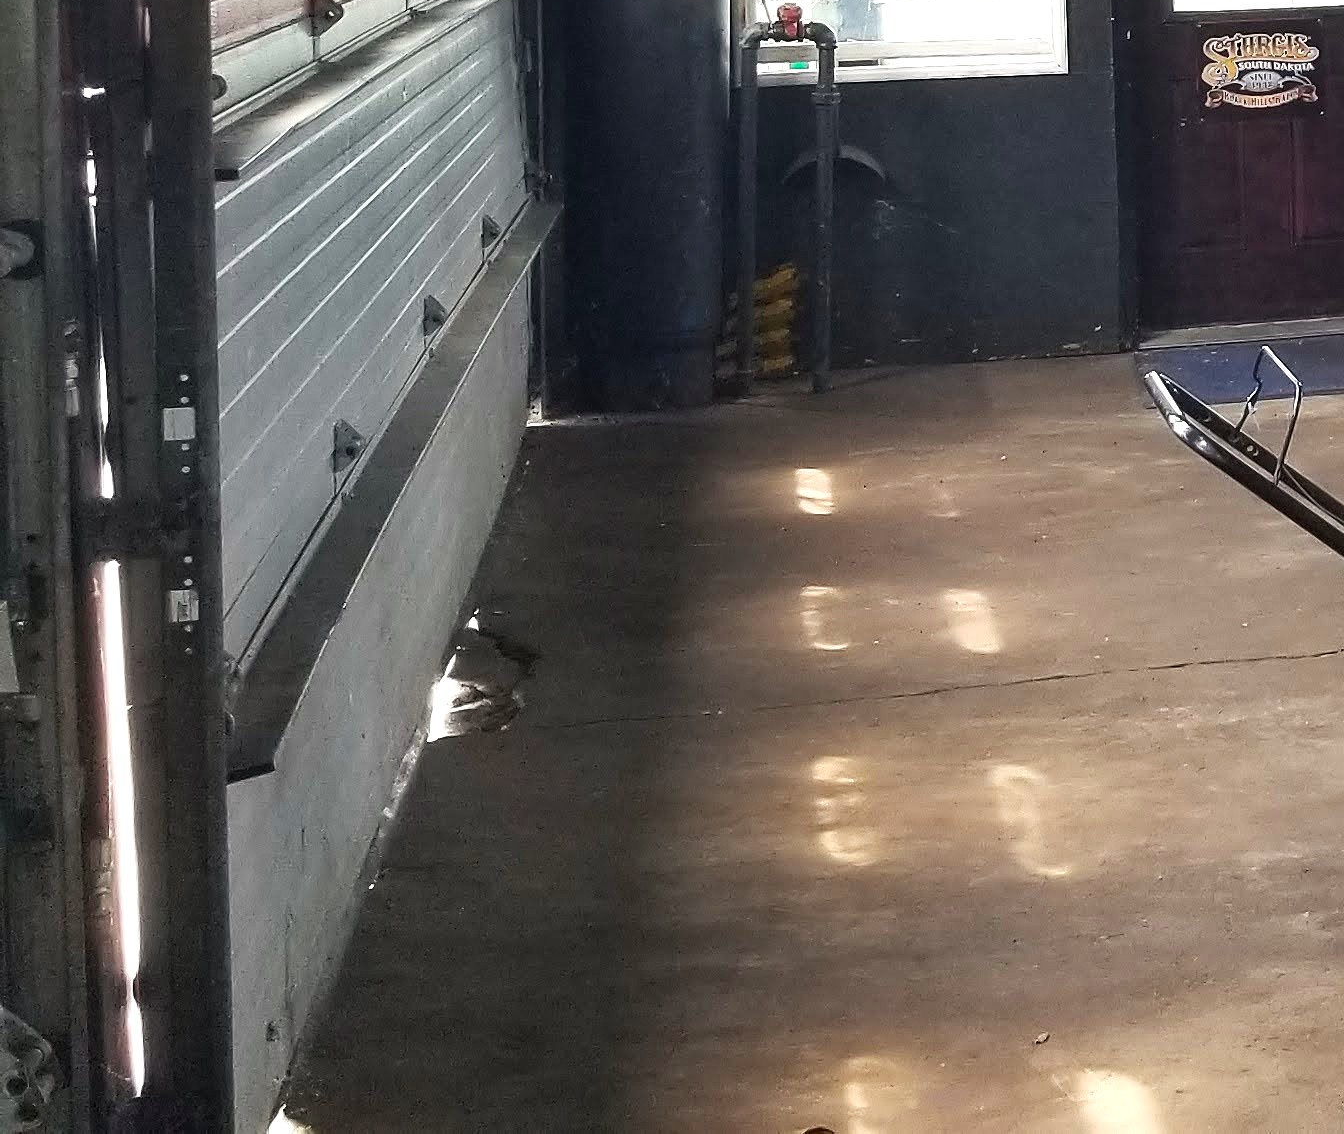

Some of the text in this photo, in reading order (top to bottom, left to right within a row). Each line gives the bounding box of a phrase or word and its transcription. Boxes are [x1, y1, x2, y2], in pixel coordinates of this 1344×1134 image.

[1202, 33, 1320, 85] STURGIS
[1238, 61, 1315, 72] SOUTH DAKOTA
